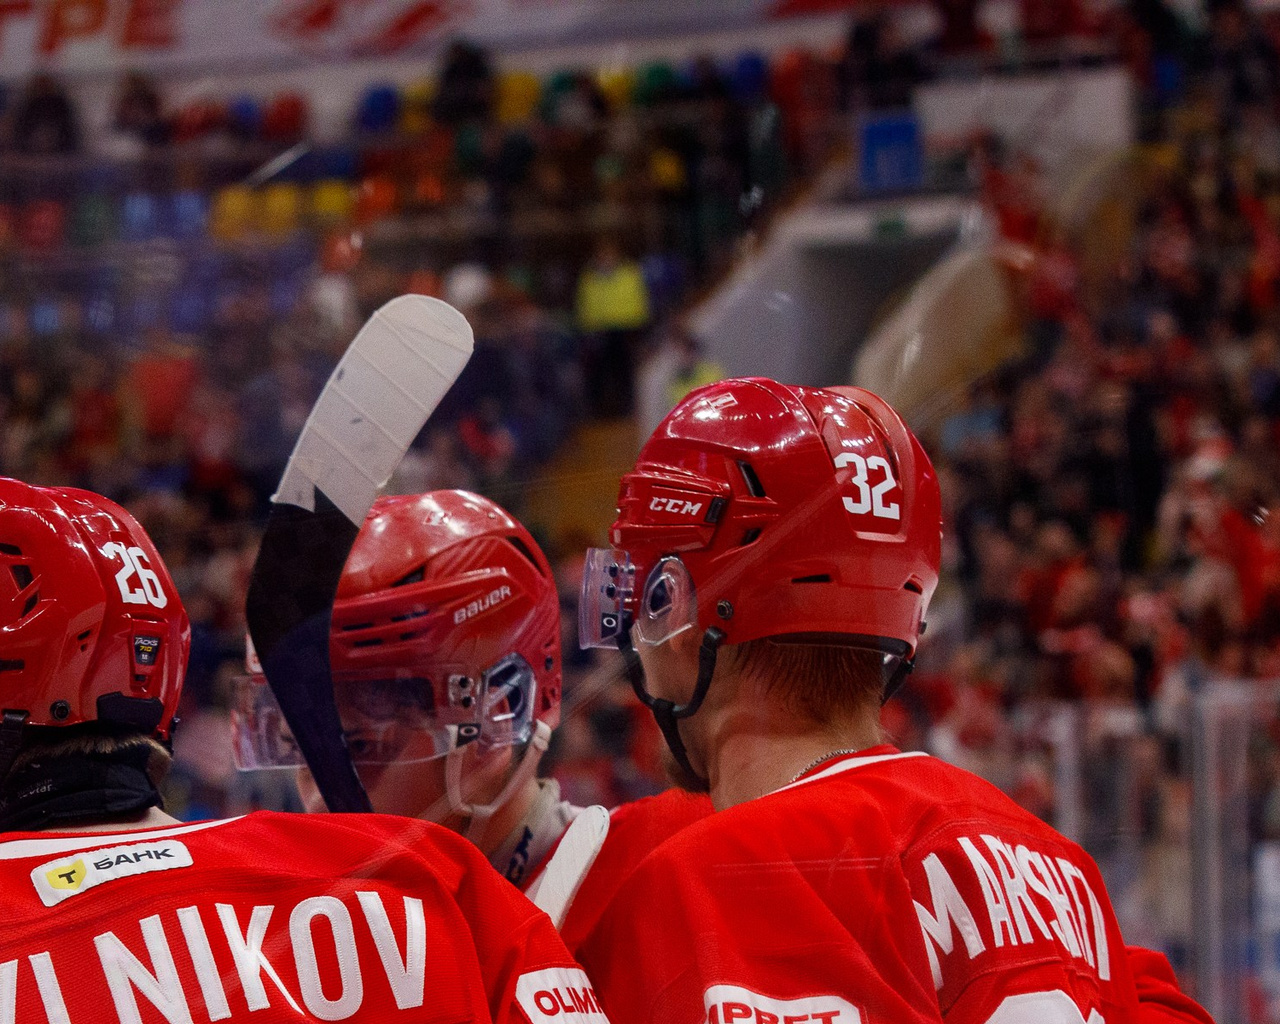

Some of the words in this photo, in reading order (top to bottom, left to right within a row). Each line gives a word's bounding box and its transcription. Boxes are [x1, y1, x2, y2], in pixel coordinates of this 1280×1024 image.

[649, 495, 703, 517] CCM
[833, 451, 901, 521] 32
[101, 541, 168, 609] 26
[93, 848, 176, 871] БАНК
